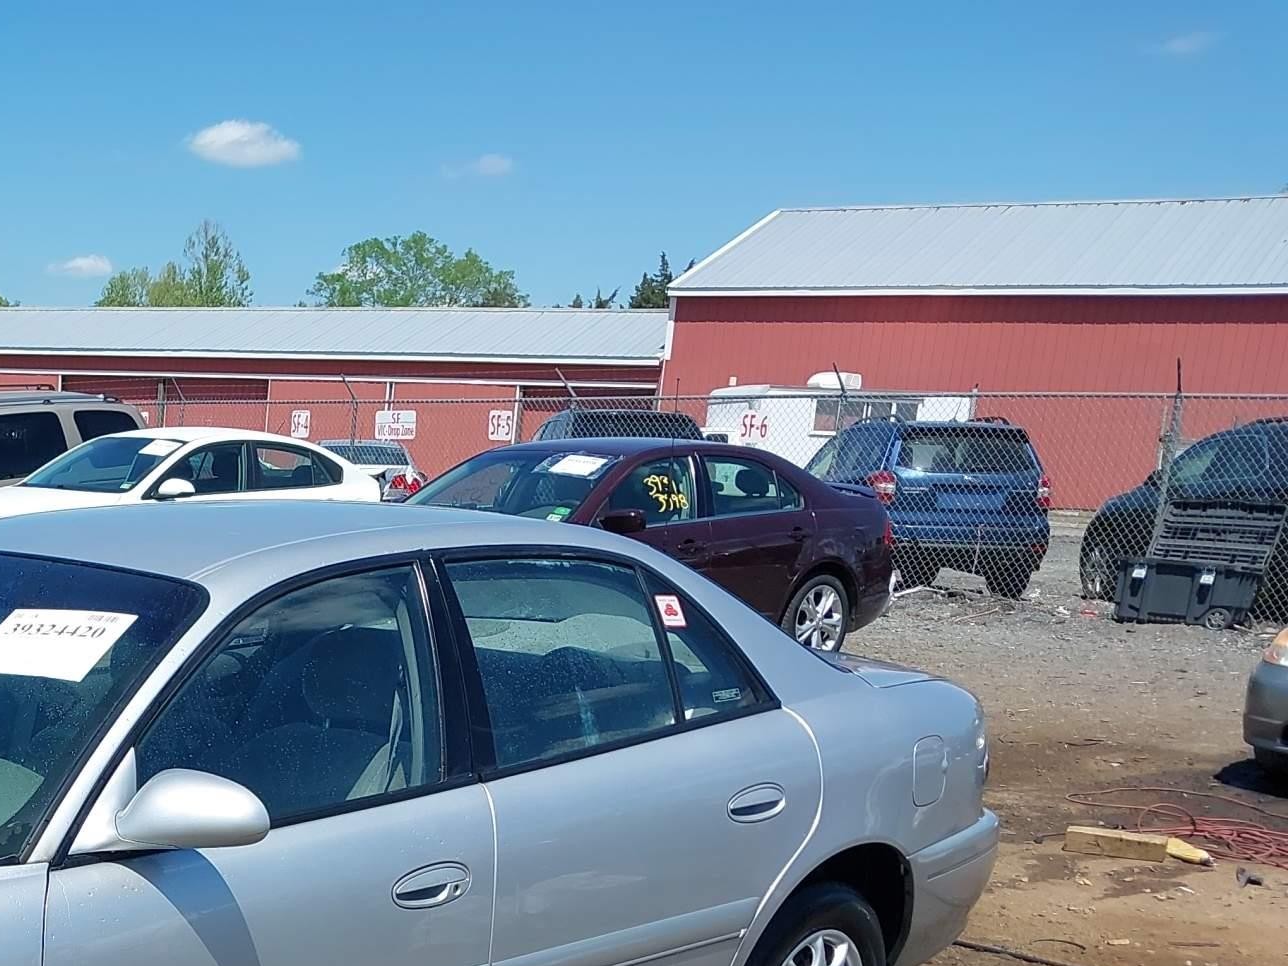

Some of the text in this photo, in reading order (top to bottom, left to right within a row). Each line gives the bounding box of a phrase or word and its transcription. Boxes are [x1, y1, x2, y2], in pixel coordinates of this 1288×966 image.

[292, 414, 309, 434] SF-4
[392, 412, 402, 424] SF
[490, 414, 512, 436] SF-5
[741, 414, 768, 438] SF-6
[4, 622, 107, 639] 39324420
